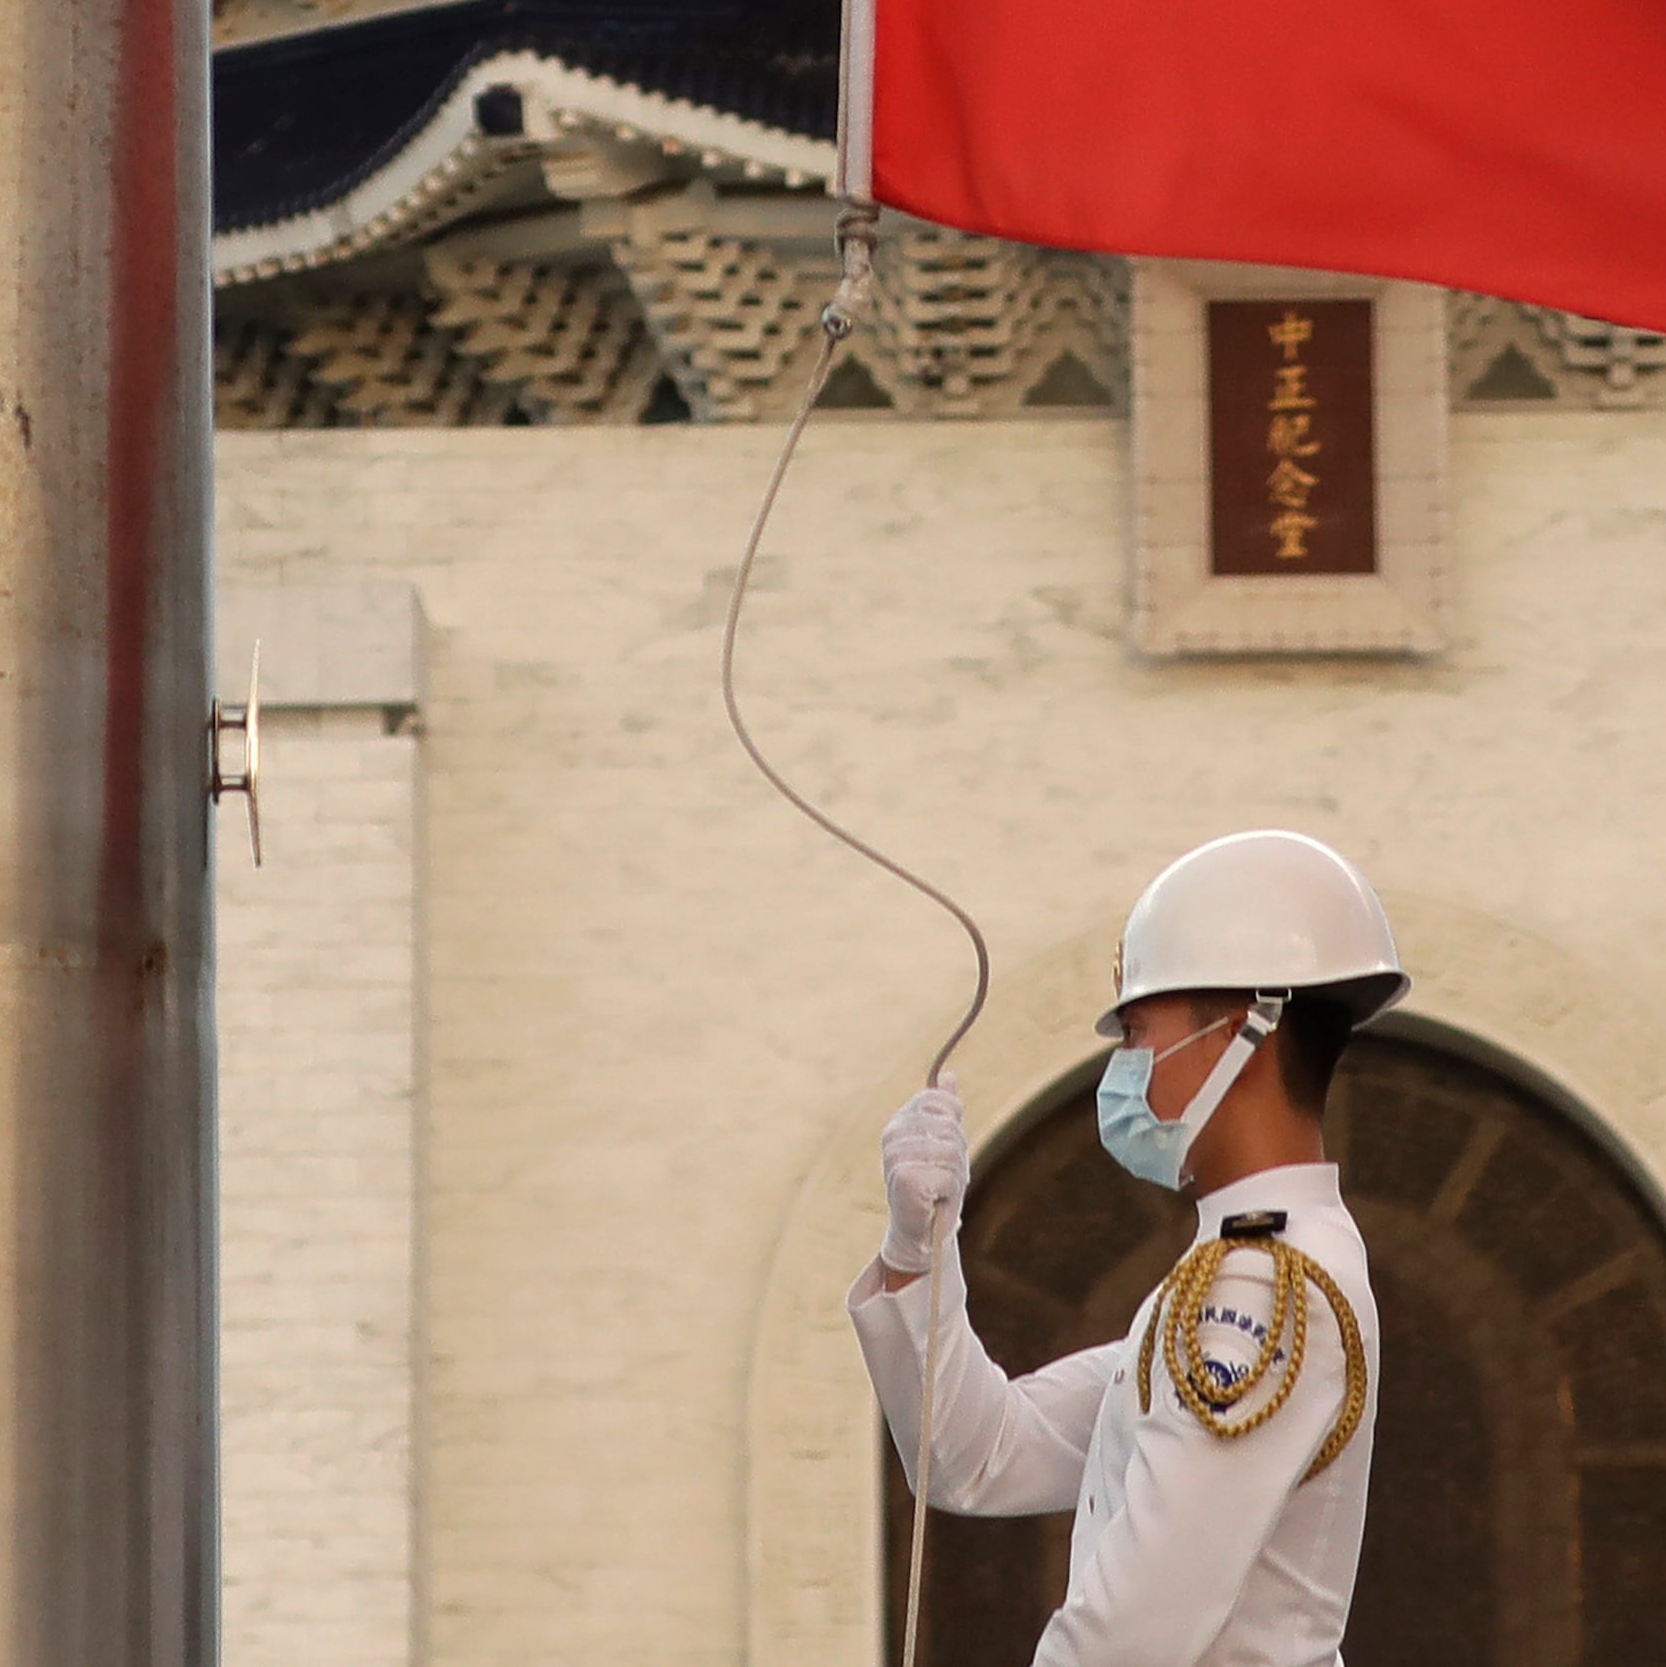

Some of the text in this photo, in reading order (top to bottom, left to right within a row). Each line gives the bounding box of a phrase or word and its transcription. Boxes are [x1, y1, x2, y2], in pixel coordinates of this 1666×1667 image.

[1266, 310, 1322, 559] 中正紀念堂
